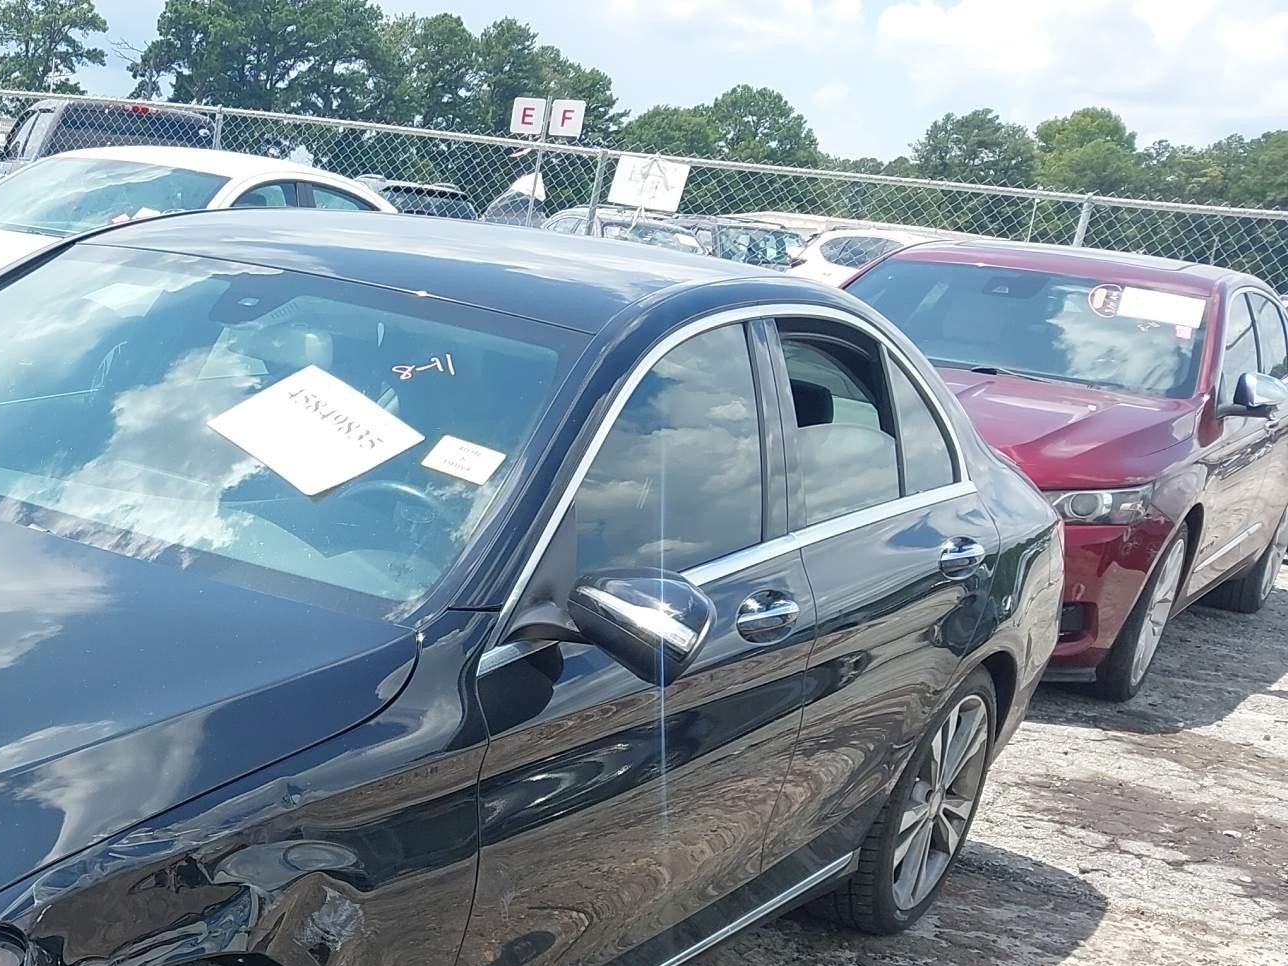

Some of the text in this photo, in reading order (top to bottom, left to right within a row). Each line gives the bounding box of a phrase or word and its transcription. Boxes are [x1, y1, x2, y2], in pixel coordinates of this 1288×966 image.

[521, 107, 534, 126] E
[560, 109, 575, 128] F
[287, 388, 385, 449] 45849835
